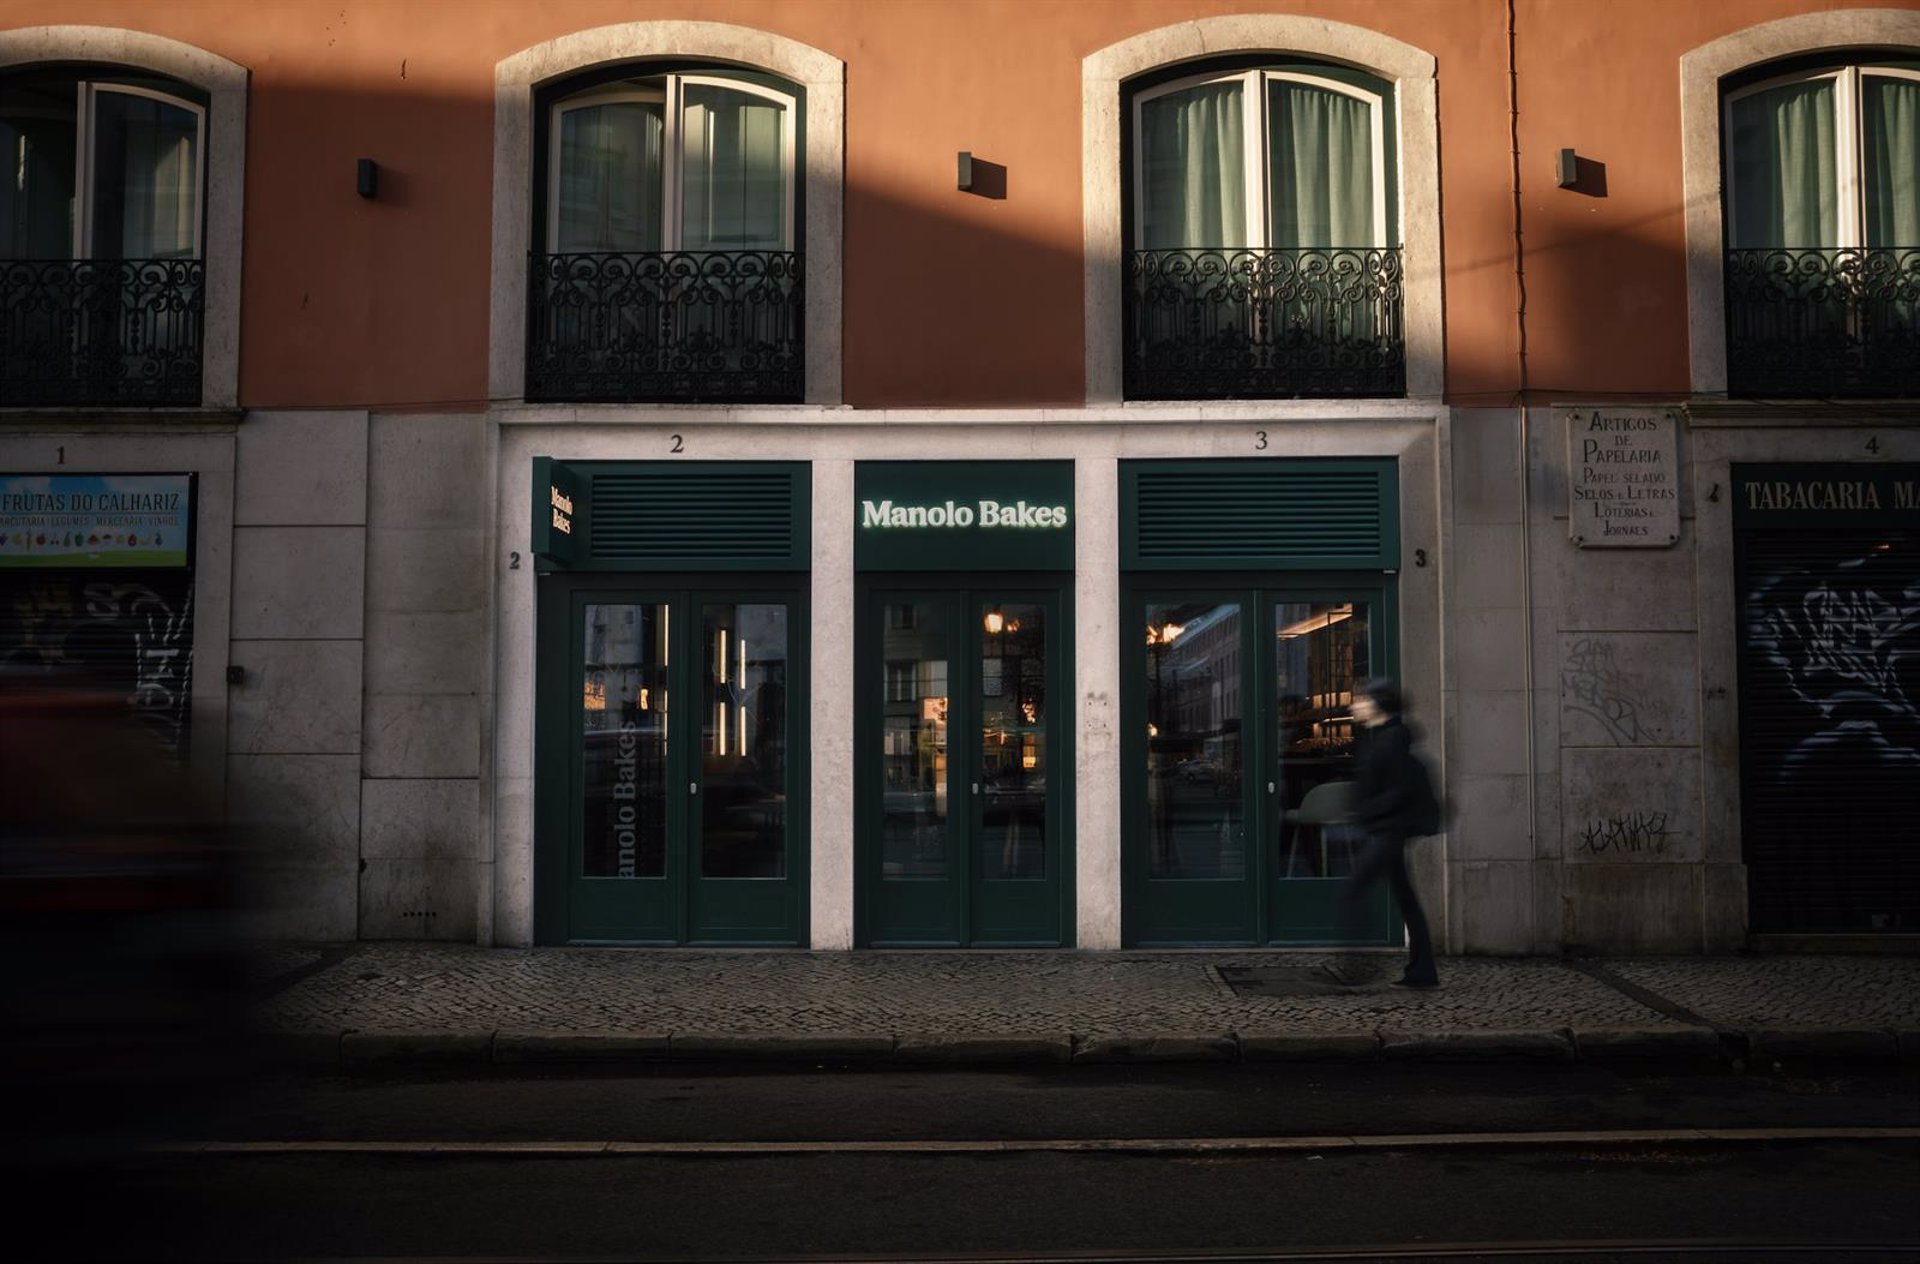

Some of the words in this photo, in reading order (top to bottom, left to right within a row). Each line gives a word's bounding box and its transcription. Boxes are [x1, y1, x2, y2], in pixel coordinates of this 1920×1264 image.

[1589, 411, 1657, 431] ARTIGOS
[669, 433, 685, 454] 2
[1255, 430, 1268, 450] 3
[1614, 435, 1632, 446] DE
[1864, 435, 1880, 455] 4
[56, 446, 65, 465] 1
[1583, 438, 1661, 463] PAPELARIA
[1583, 467, 1614, 484] PAPEL
[2, 493, 66, 512] FRUTAS
[71, 493, 93, 512] DO
[98, 493, 179, 512] CALHARIZ
[551, 485, 572, 515] Manolo
[1574, 485, 1614, 501] SELOS
[1627, 484, 1676, 501] LETRAS
[1745, 480, 1881, 510] TABACARIA
[1893, 480, 1920, 510] M
[861, 500, 973, 528] Manolo
[978, 500, 1067, 528] Bakes
[1594, 502, 1649, 518] LOTERIAS
[1603, 520, 1649, 536] JORNAES
[509, 551, 520, 570] 2
[1415, 548, 1426, 568] 3
[613, 721, 636, 800] Bakes
[613, 806, 636, 878] anolo
